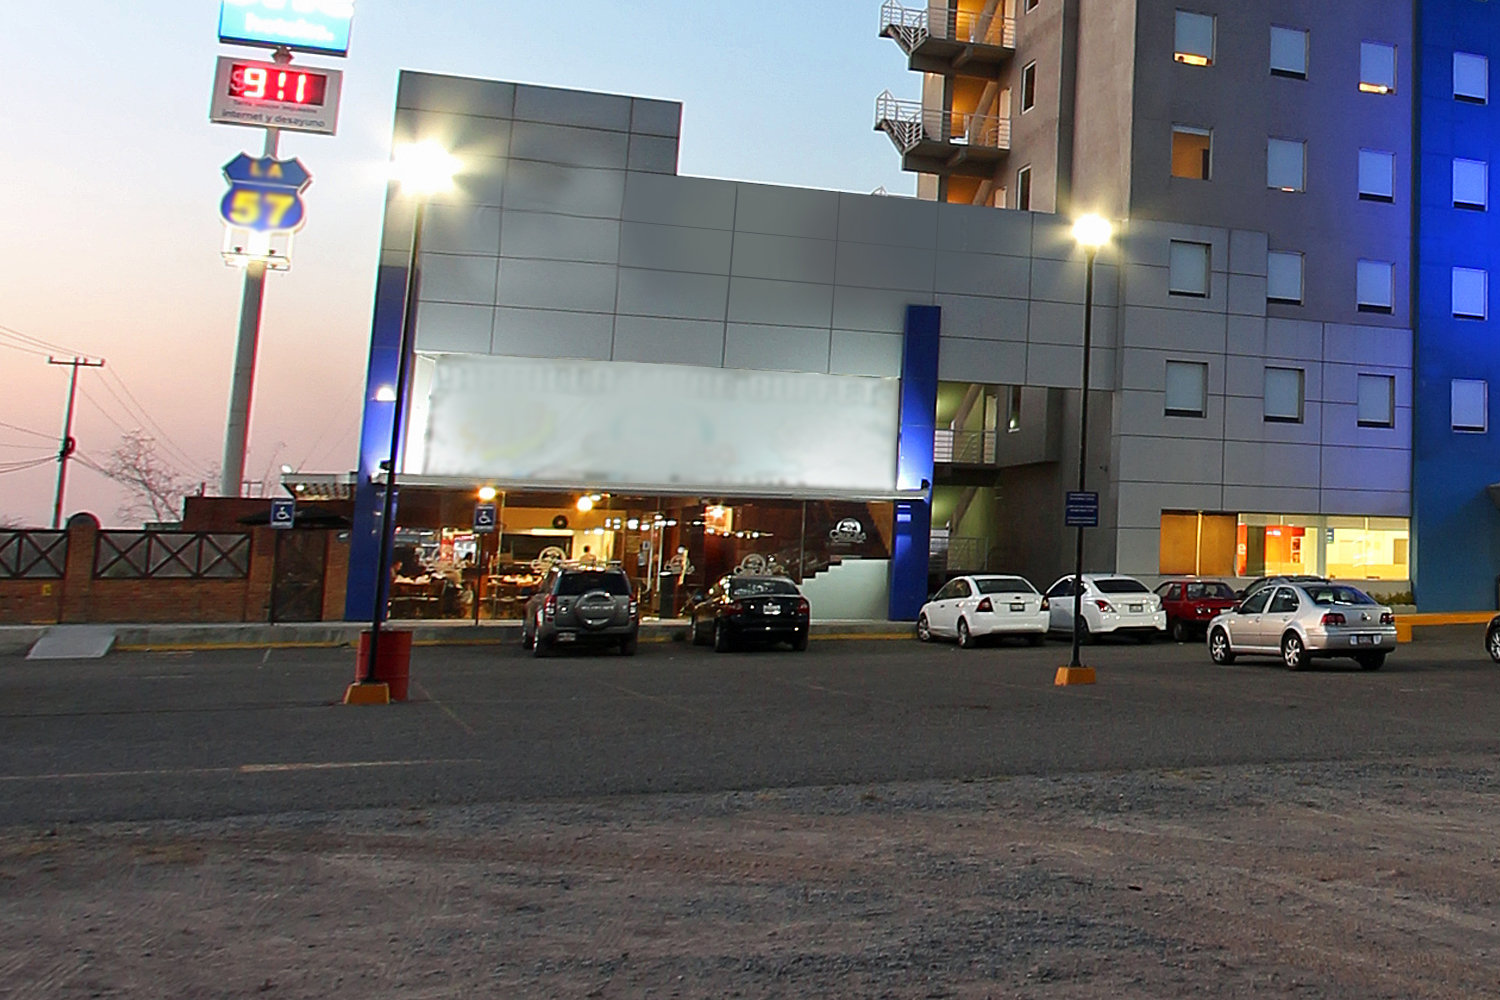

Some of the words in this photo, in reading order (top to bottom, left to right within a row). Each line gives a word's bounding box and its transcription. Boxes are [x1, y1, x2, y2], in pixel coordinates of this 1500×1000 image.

[222, 108, 263, 121] internet
[275, 114, 325, 127] desayuno
[249, 161, 283, 178] LA
[230, 189, 295, 227] 57
